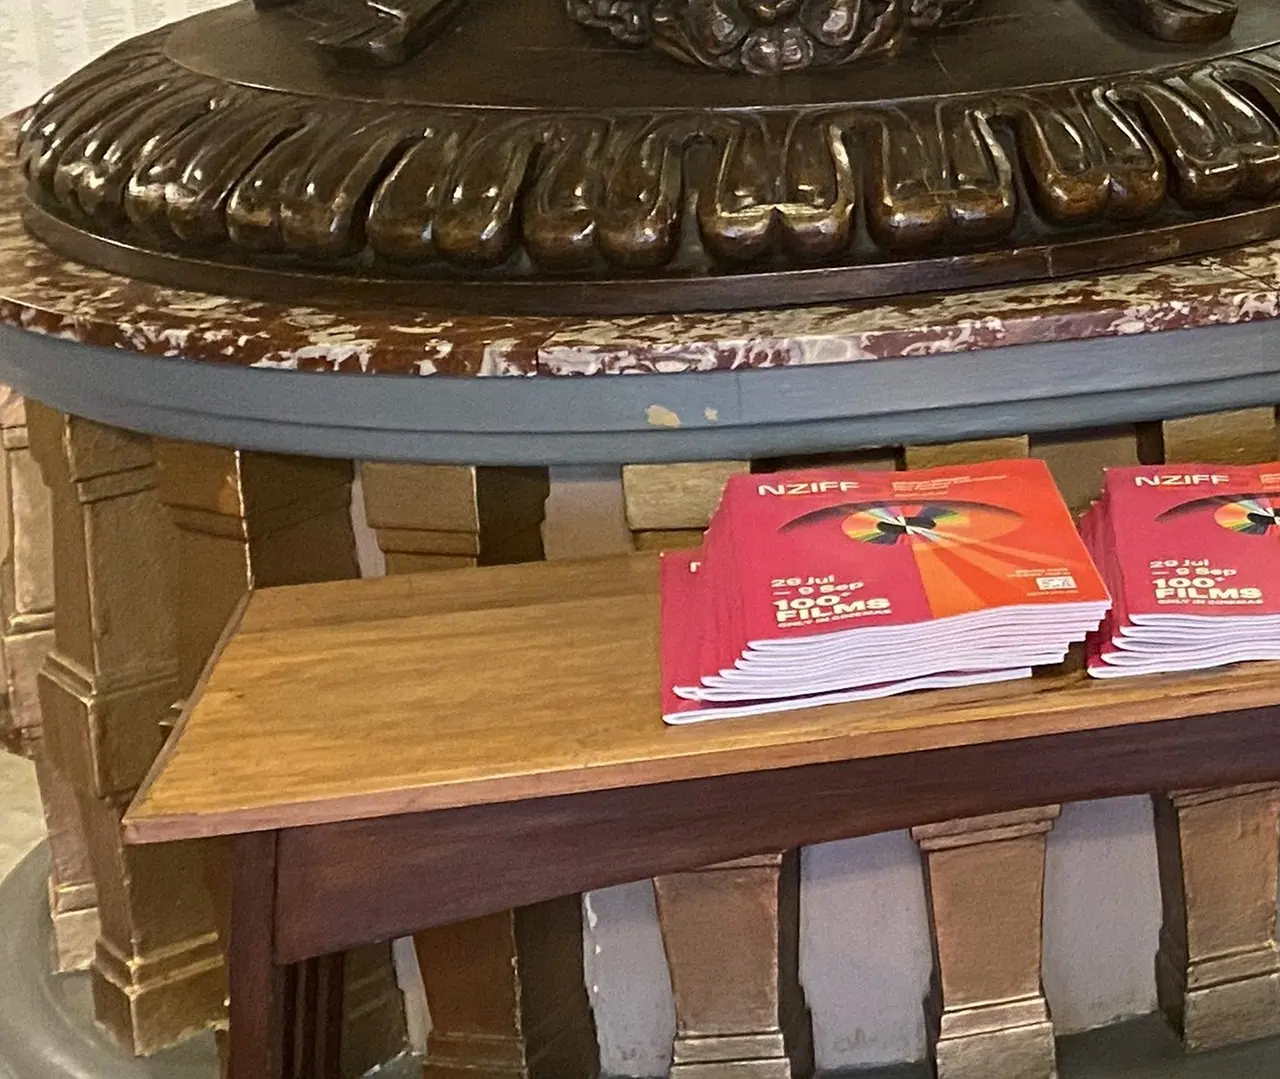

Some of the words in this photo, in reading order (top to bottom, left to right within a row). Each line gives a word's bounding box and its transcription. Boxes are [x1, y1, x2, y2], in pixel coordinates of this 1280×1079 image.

[1135, 473, 1230, 487] NZIFF
[758, 480, 860, 497] NZIFF
[806, 574, 835, 585] Jul
[1155, 587, 1262, 599] FILMS
[775, 597, 891, 622] FILMS
